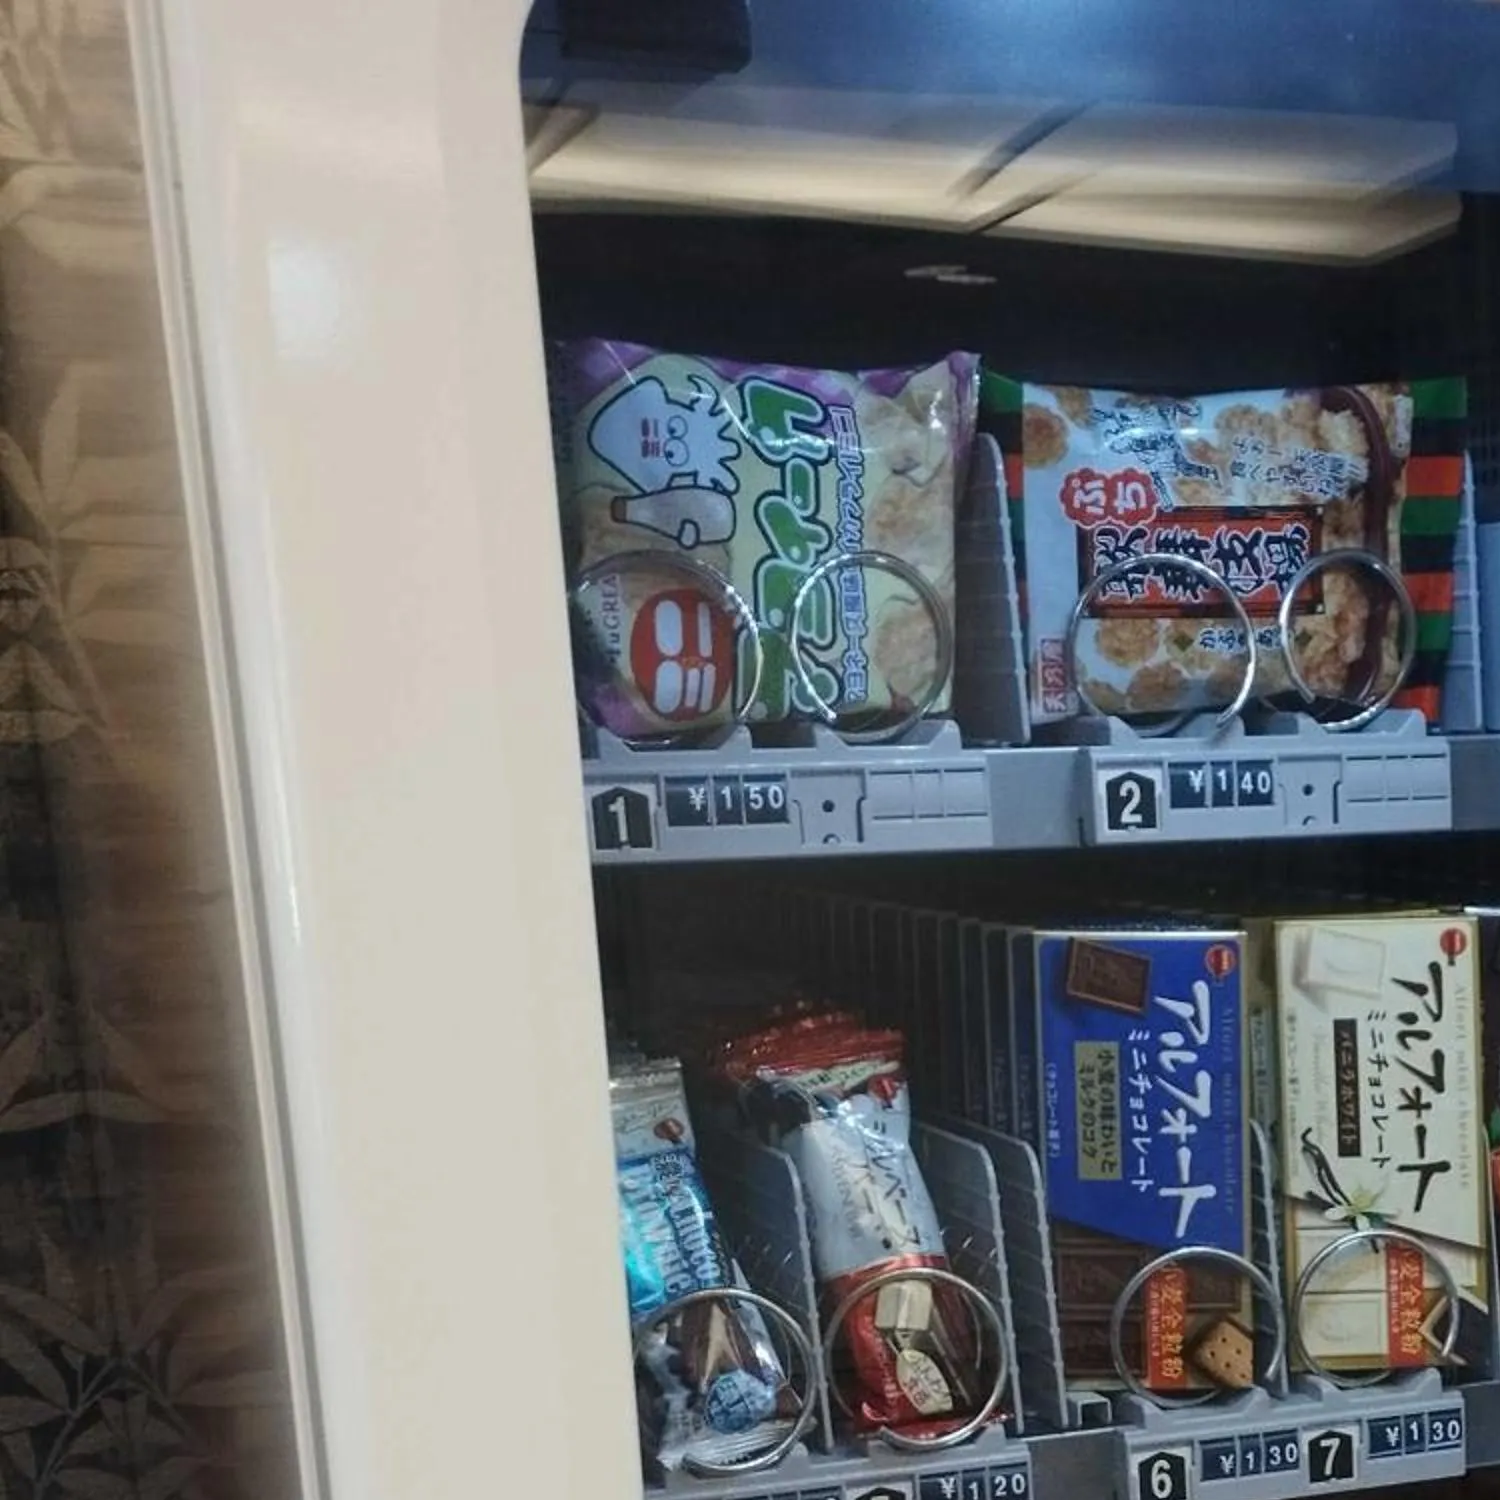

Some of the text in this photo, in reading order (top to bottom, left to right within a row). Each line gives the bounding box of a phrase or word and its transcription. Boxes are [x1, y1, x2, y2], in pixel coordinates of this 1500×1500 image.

[1072, 475, 1150, 521] ぷち
[607, 785, 785, 843] 1 ¥150
[1118, 768, 1271, 824] 2 ¥140
[1080, 1060, 1097, 1160] ミルクのコク
[1097, 1048, 1118, 1174] 小麦の味わいと
[1127, 1028, 1155, 1195] ミニチョコレート
[1153, 978, 1218, 1240] アルフォート
[1339, 1030, 1356, 1147] バニラホワイト
[1366, 1008, 1392, 1171] ミニチョコレート
[1390, 960, 1452, 1213] アルフォート
[1150, 1441, 1298, 1500] 6 ¥130
[1319, 1417, 1461, 1475] 7 ¥130
